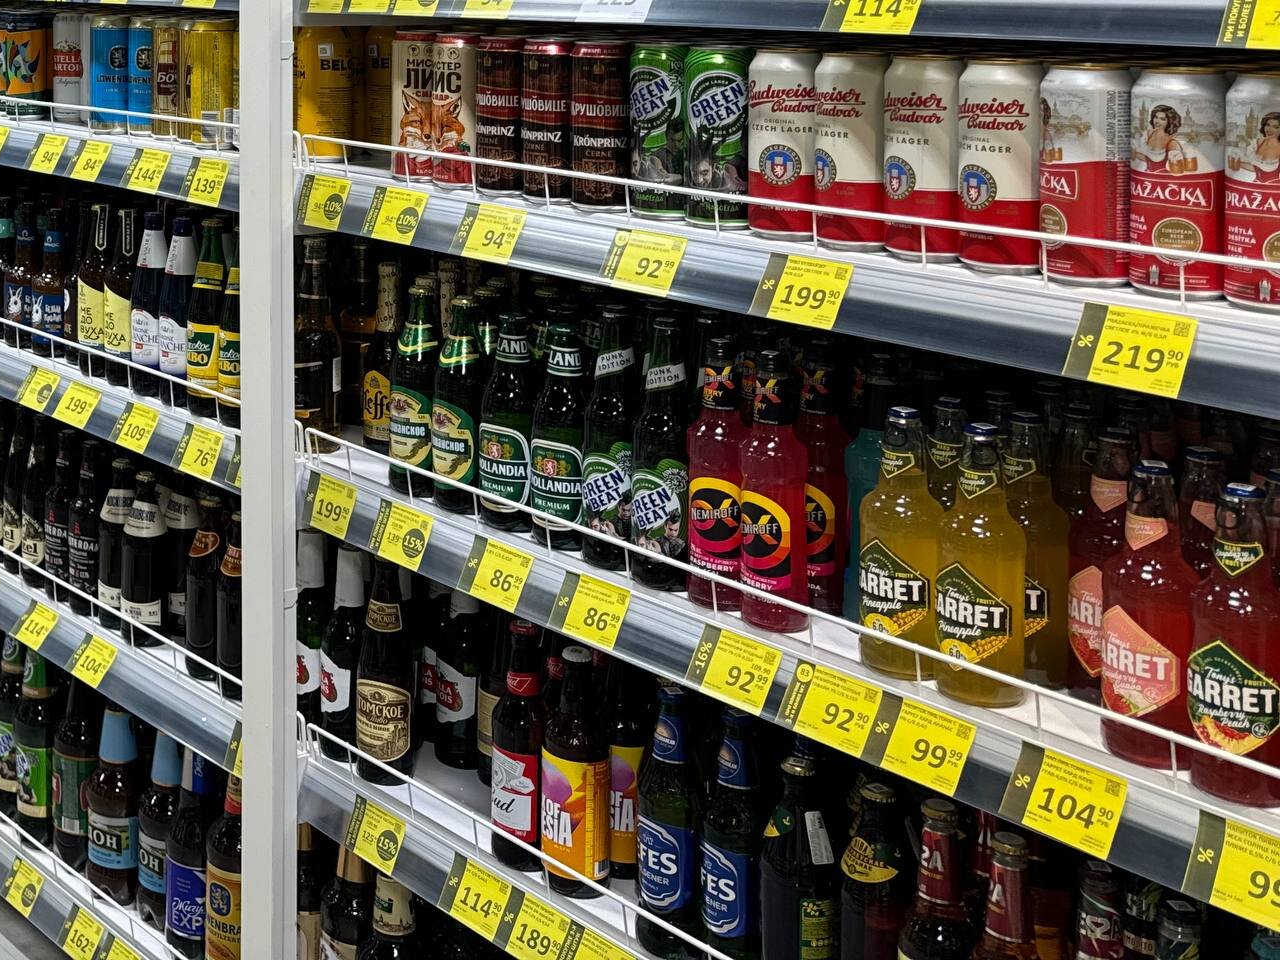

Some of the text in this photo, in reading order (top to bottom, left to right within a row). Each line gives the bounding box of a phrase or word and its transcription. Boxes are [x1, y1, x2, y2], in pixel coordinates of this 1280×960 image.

[1238, 3, 1252, 30] БОЛЕЕ
[1223, 25, 1235, 43] ПРИ
[691, 82, 745, 120] GREEN
[705, 100, 744, 128] BEAT
[752, 124, 813, 135] CZECH LAGER
[896, 136, 930, 146] LAGER
[974, 144, 1012, 154] LAGER
[134, 167, 155, 183] 144
[193, 177, 216, 195] 139
[397, 214, 417, 228] 10%
[458, 216, 473, 243] -35%
[481, 229, 504, 250] 94
[635, 256, 675, 280] 92 99
[779, 283, 841, 311] 199 90
[1102, 340, 1184, 374] 219 90
[316, 498, 343, 521] 199
[535, 497, 570, 511] PREMIUM
[691, 504, 739, 521] NEMIROFF
[404, 535, 425, 552] 15%
[490, 569, 524, 592] 86 99
[583, 607, 620, 631] 86 99
[938, 620, 982, 639] Pineapple
[695, 641, 713, 676] -16%
[725, 665, 769, 694] 92 99
[800, 667, 810, 678] 83
[821, 702, 870, 733] 92 90
[1221, 716, 1251, 730] Peach
[911, 738, 964, 770] 99 99
[1037, 787, 1115, 830] 104 90
[459, 886, 503, 919] 114 90
[515, 922, 562, 957] 189 90
